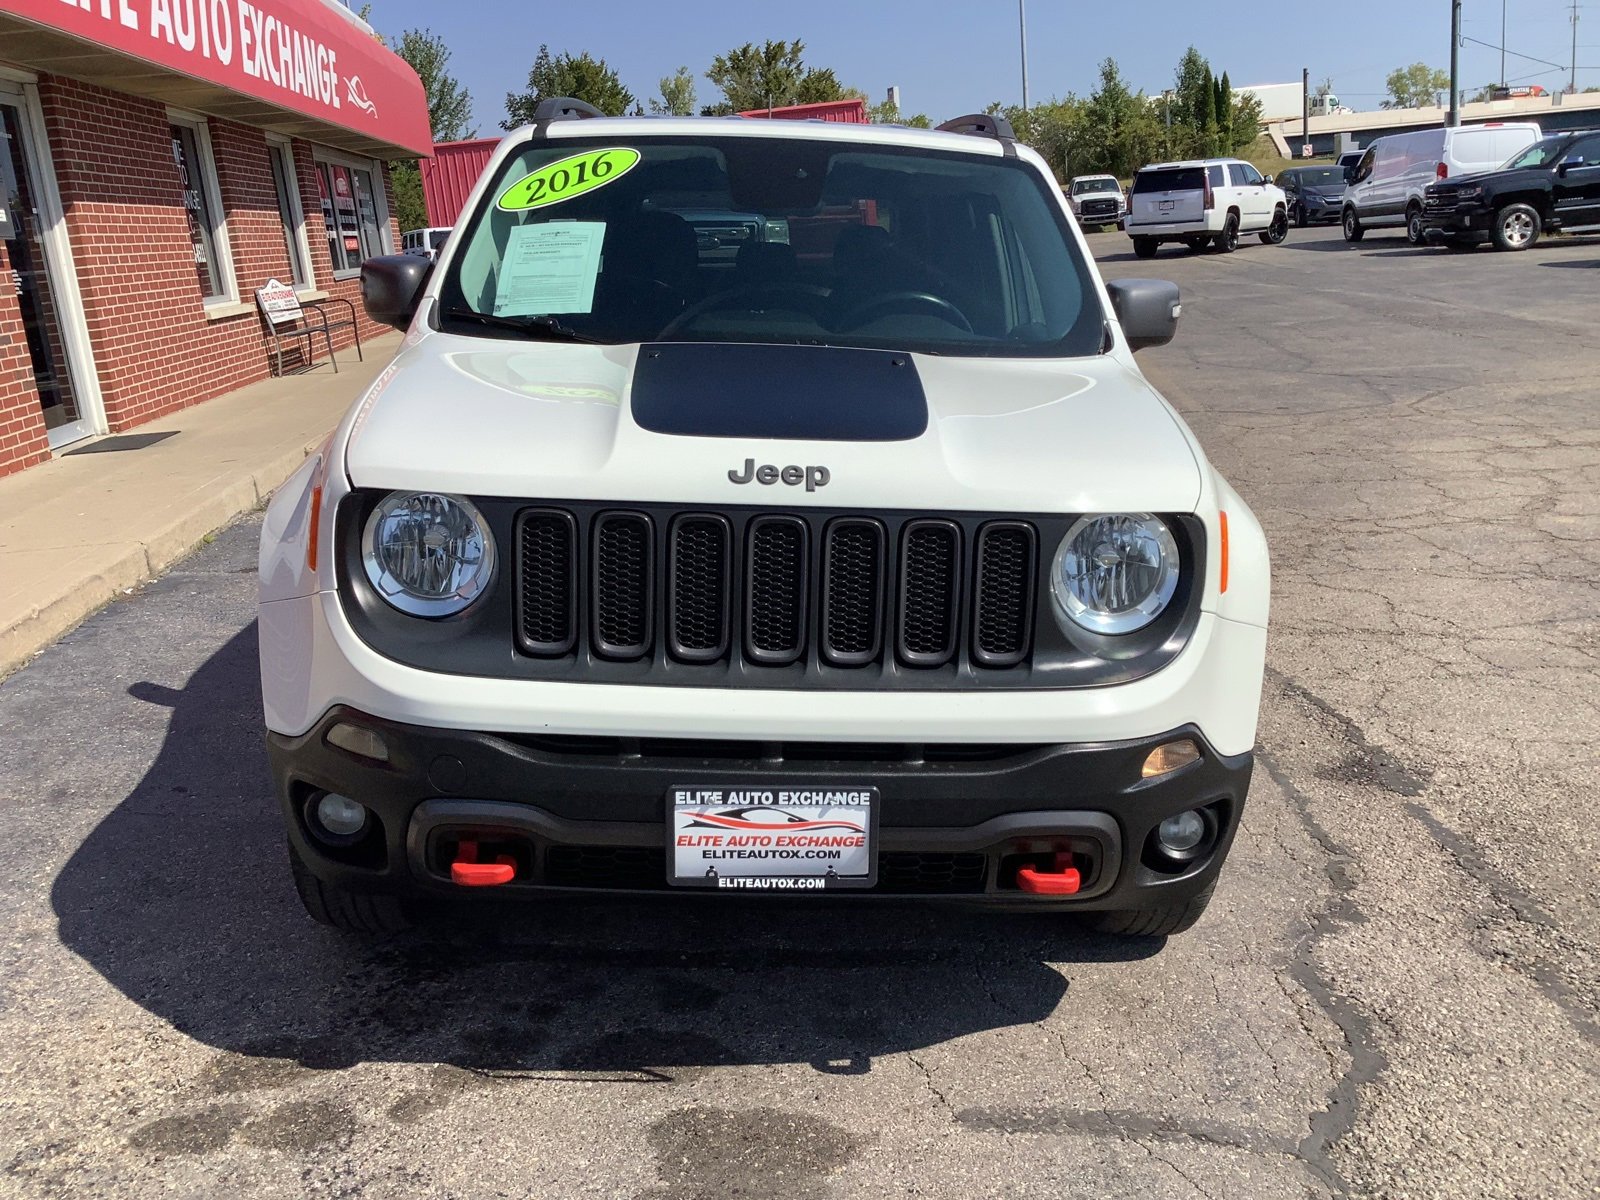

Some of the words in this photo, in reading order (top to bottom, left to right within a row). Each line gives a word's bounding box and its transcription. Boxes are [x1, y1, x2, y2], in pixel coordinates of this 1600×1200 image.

[238, 0, 340, 110] EXCHANGE
[526, 152, 613, 205] 2016
[728, 458, 831, 492] Jeep
[675, 791, 723, 805] ELITE
[727, 791, 774, 805] AUTO
[778, 791, 870, 806] EXCHANGE
[676, 835, 723, 847] ELITE
[725, 835, 772, 847] AUTO
[775, 836, 866, 848] EXCHANGE
[702, 850, 841, 859] ELITEAUTOX.COM
[718, 878, 826, 889] ELITEAUTOX.COM
